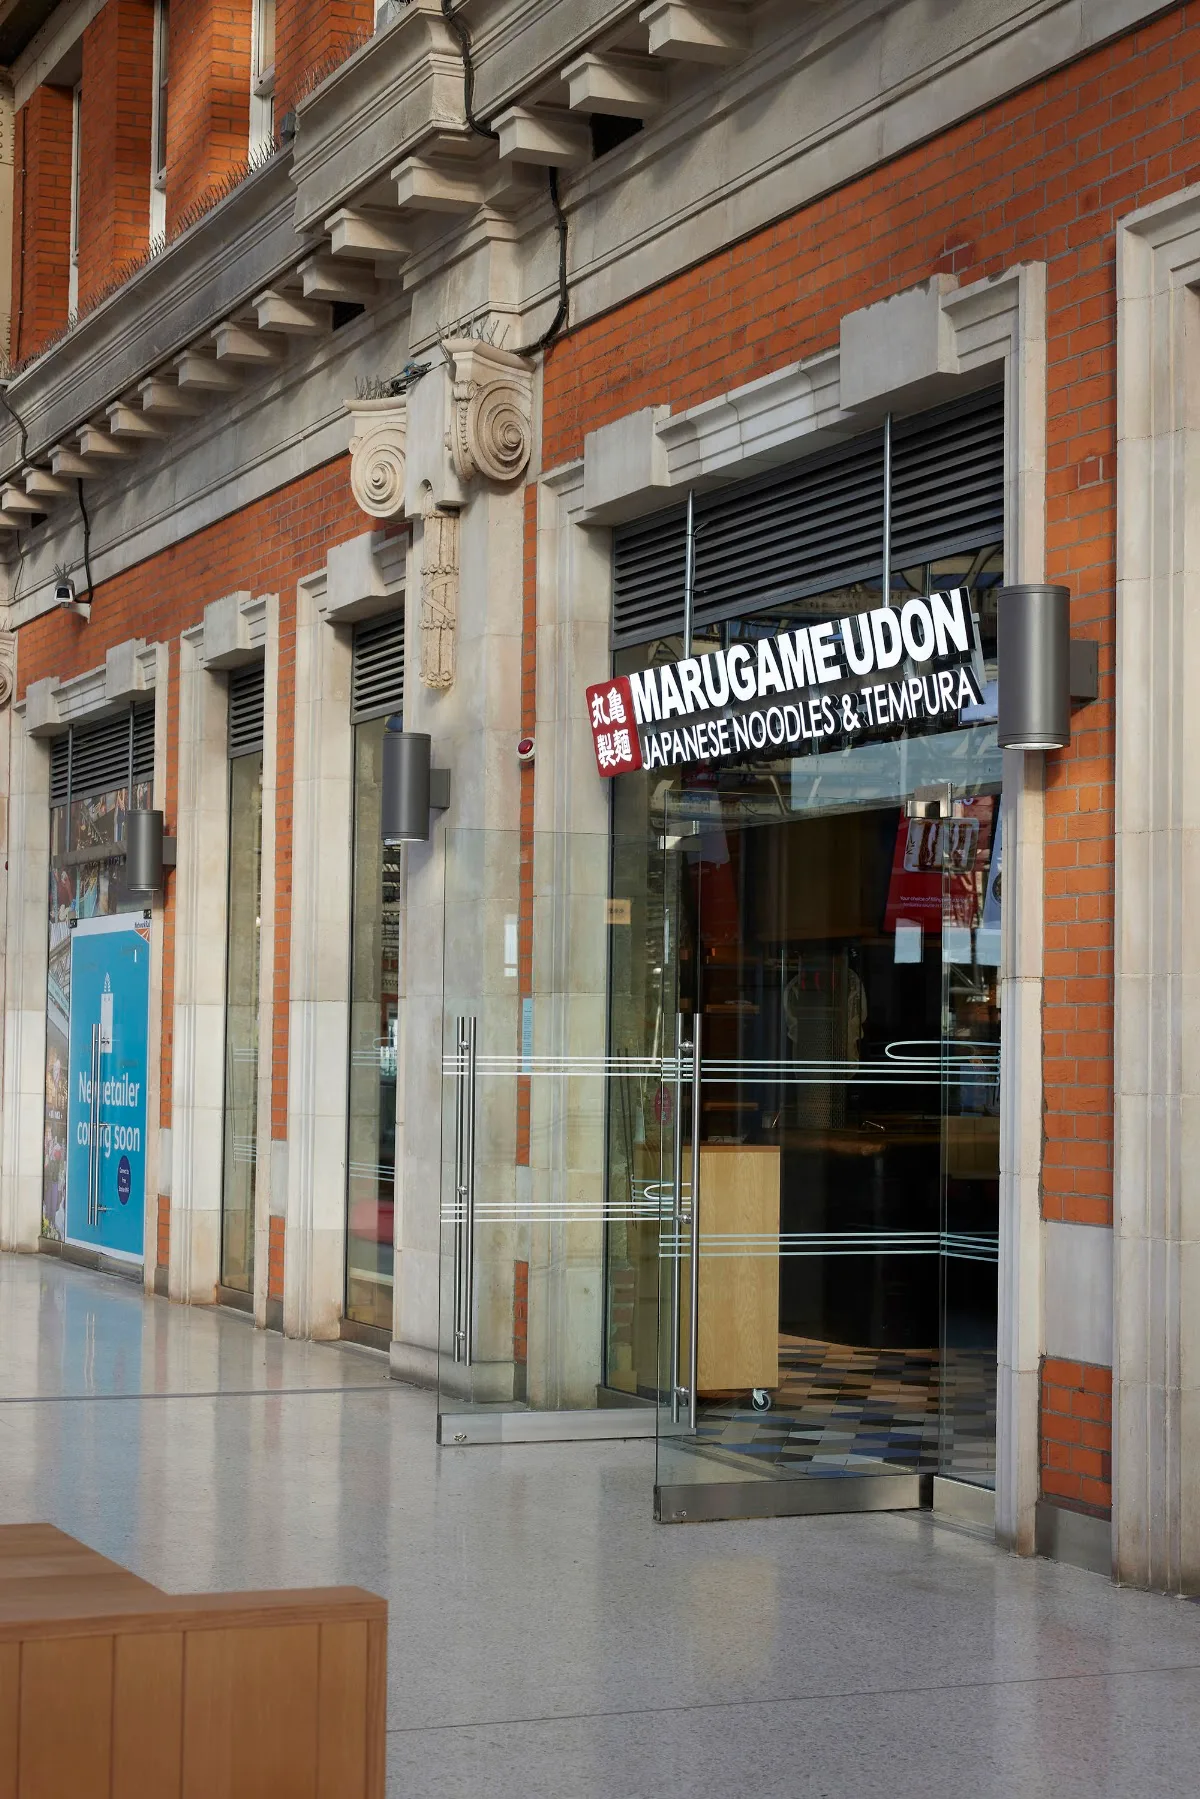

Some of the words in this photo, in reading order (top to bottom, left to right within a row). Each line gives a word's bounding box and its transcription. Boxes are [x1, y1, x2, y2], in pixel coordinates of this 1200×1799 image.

[628, 621, 843, 725] MARUGAME
[842, 586, 972, 677] UDON
[642, 717, 731, 771] JAPANESE
[731, 700, 834, 751] NOODLES
[842, 694, 861, 732] &
[860, 667, 979, 727] TEMPURA
[114, 1125, 140, 1152] soon
